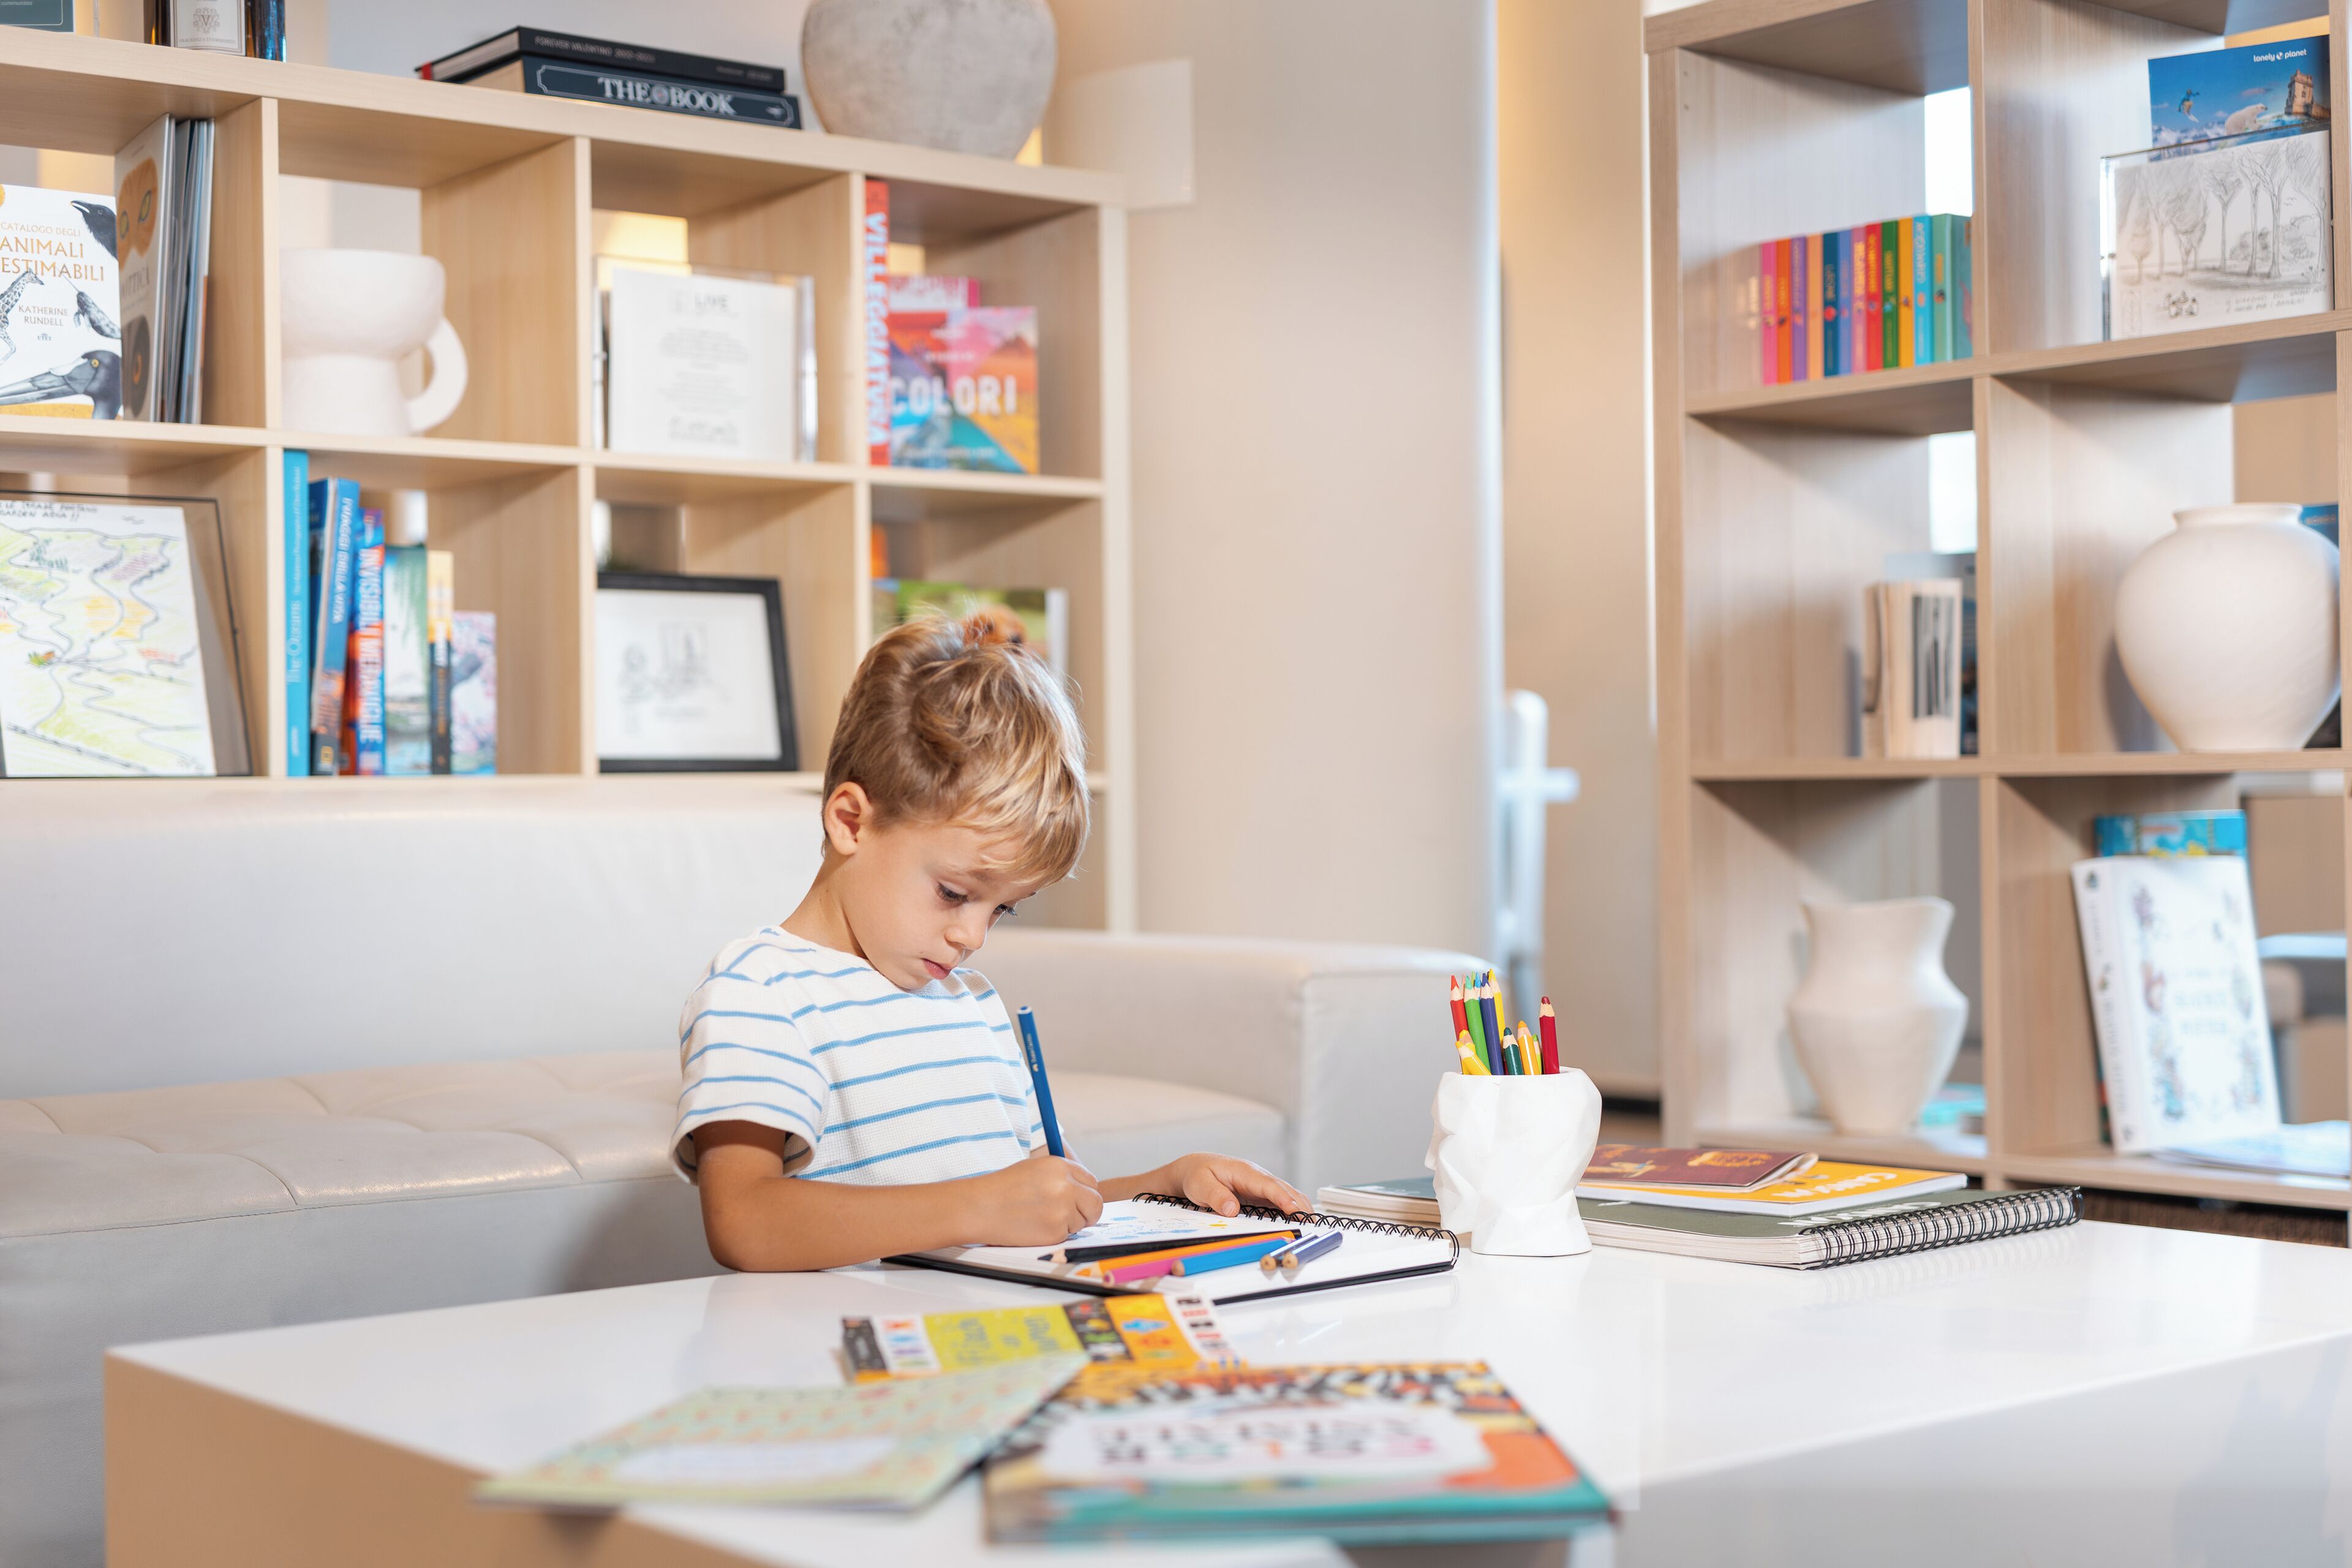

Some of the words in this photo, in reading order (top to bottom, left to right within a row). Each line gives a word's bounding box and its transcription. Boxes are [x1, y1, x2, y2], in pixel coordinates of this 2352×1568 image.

[2253, 53, 2275, 62] lonely
[2285, 48, 2307, 59] planet
[597, 77, 652, 104] THE
[670, 86, 738, 116] BOOK
[1, 222, 53, 234] CATALOGO
[56, 227, 81, 236] DEGLI
[0, 236, 84, 258] ANIMALI
[18, 305, 69, 316] KATHERINE
[24, 316, 64, 326] RUNDELL
[865, 211, 889, 446] VILLEGGIATURA
[890, 374, 1017, 416] COLORI
[359, 548, 382, 635] INVISIBILI
[360, 638, 383, 744] MERAVIGLIE
